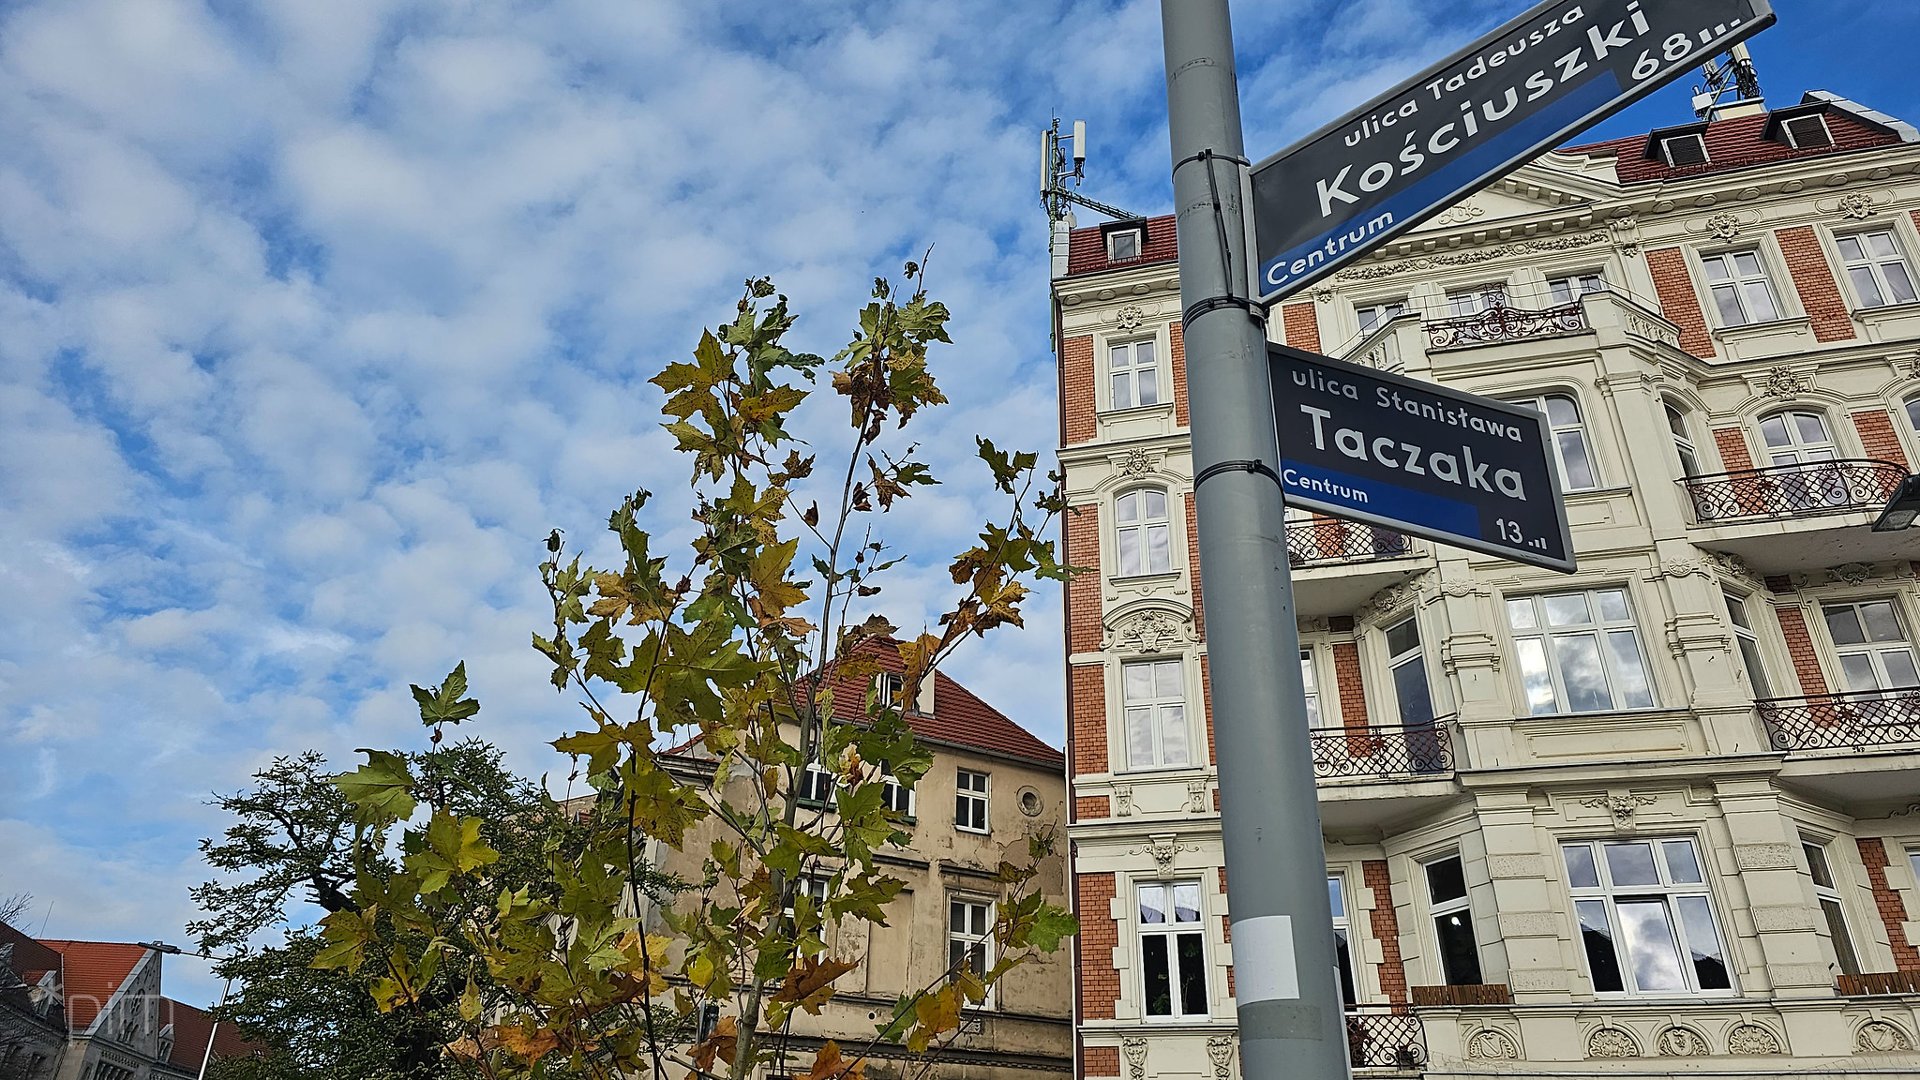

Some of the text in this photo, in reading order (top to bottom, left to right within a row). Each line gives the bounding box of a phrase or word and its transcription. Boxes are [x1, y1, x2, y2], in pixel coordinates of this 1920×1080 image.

[1316, 1, 1650, 217] Kościuszki
[1344, 5, 1585, 149] ulica Tadeusza
[1267, 211, 1394, 285] Centrum
[1292, 369, 1522, 442] ulica Stanisława
[1283, 469, 1368, 503] Centrum
[1300, 404, 1527, 501] Taczaka
